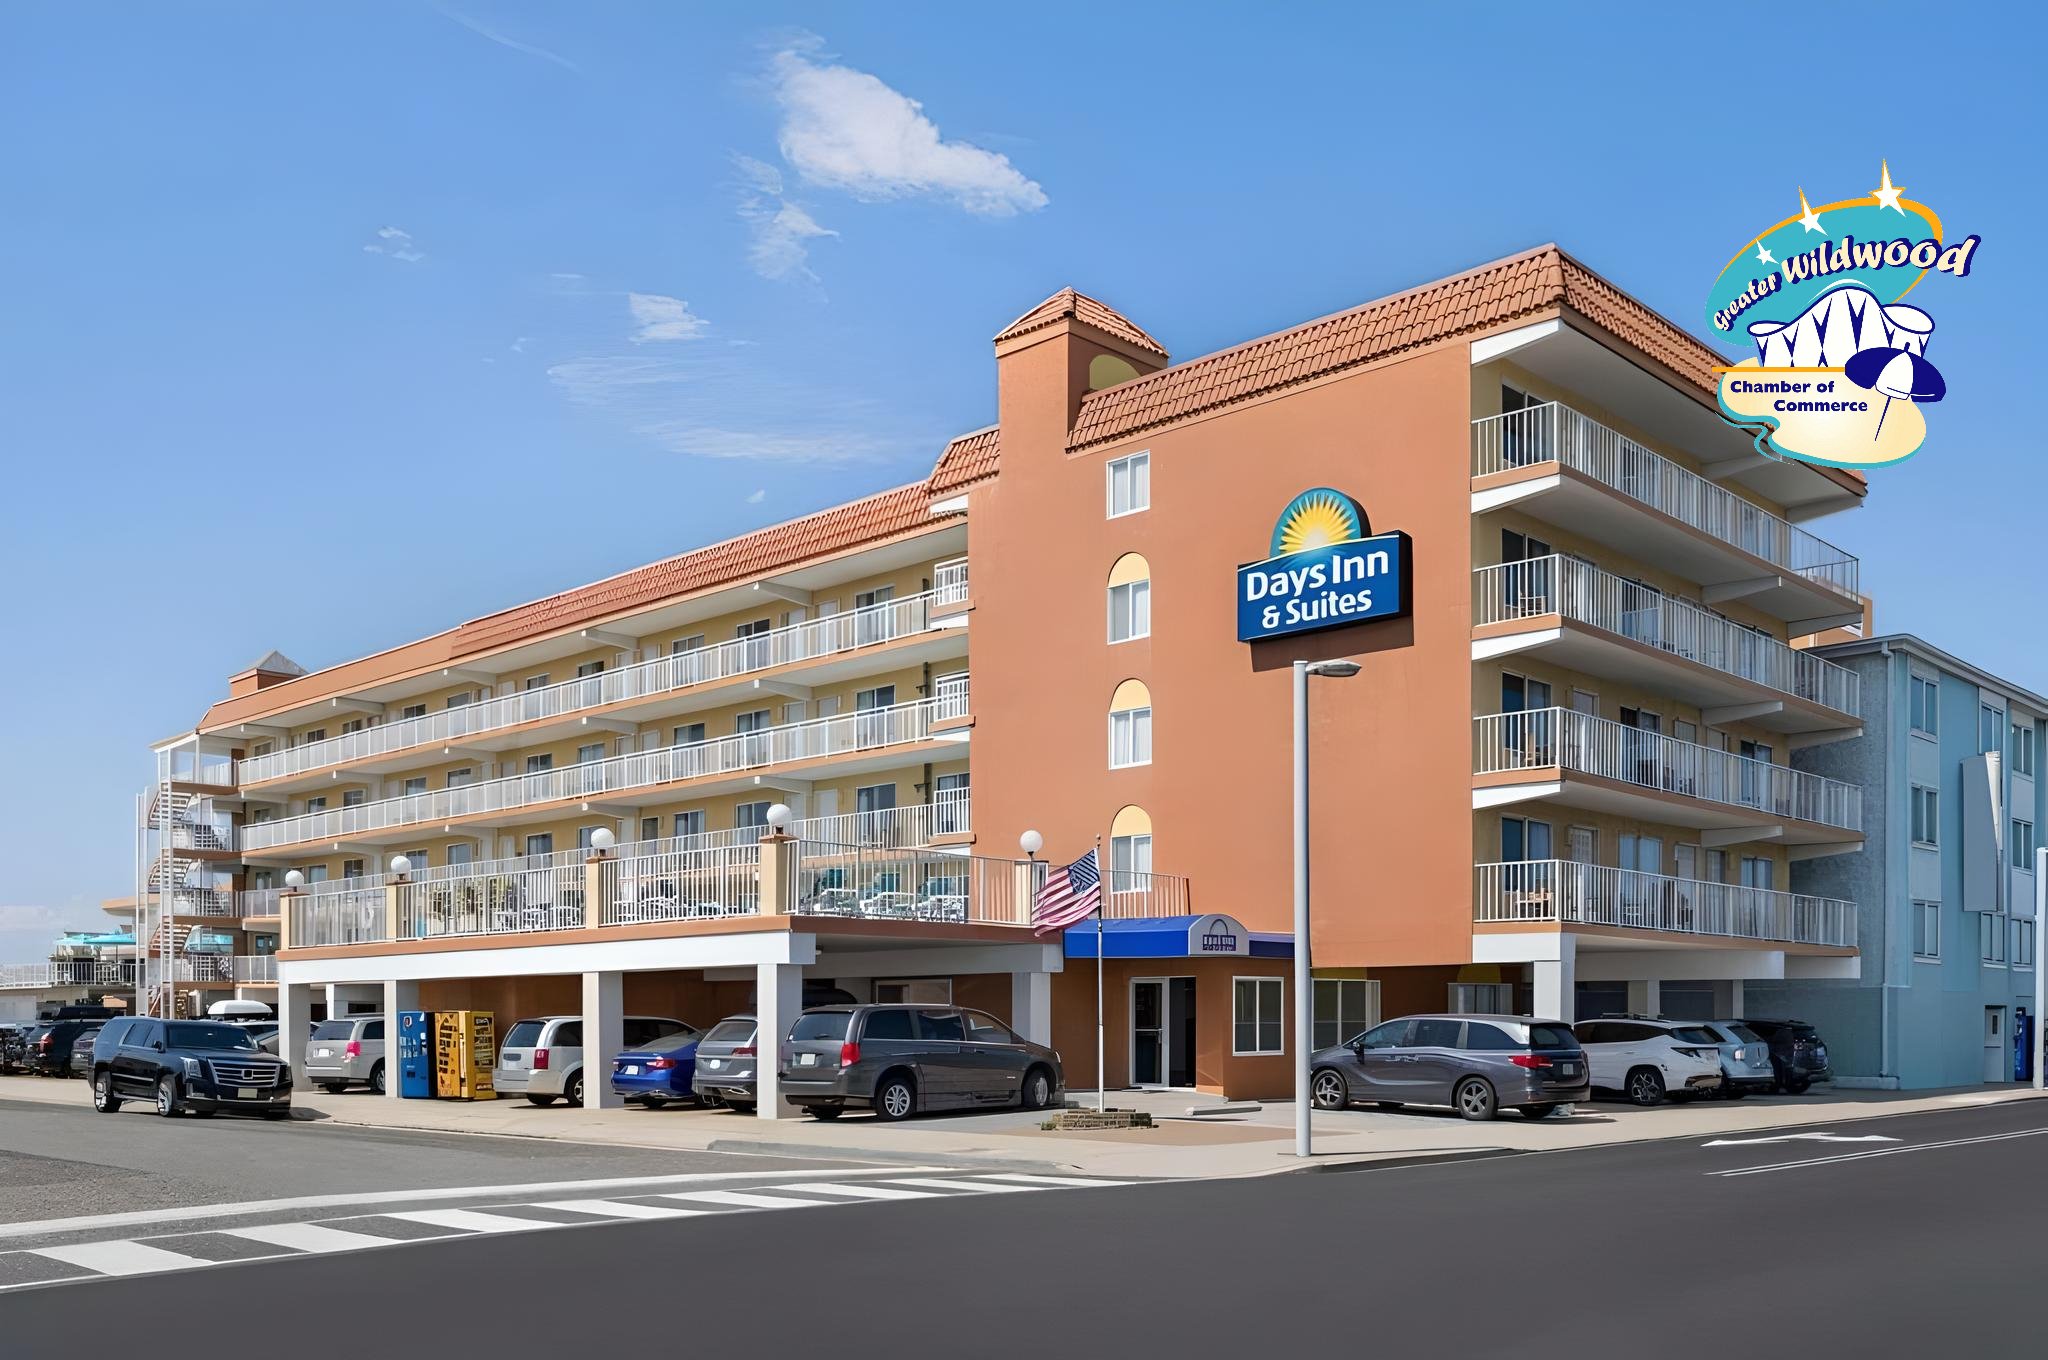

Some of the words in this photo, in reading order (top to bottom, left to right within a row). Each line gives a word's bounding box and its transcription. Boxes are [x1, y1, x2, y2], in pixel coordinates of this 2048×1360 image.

[1247, 563, 1327, 602] Days
[1332, 550, 1389, 584] Inn
[1262, 605, 1280, 629] &
[1285, 589, 1373, 624] Suites
